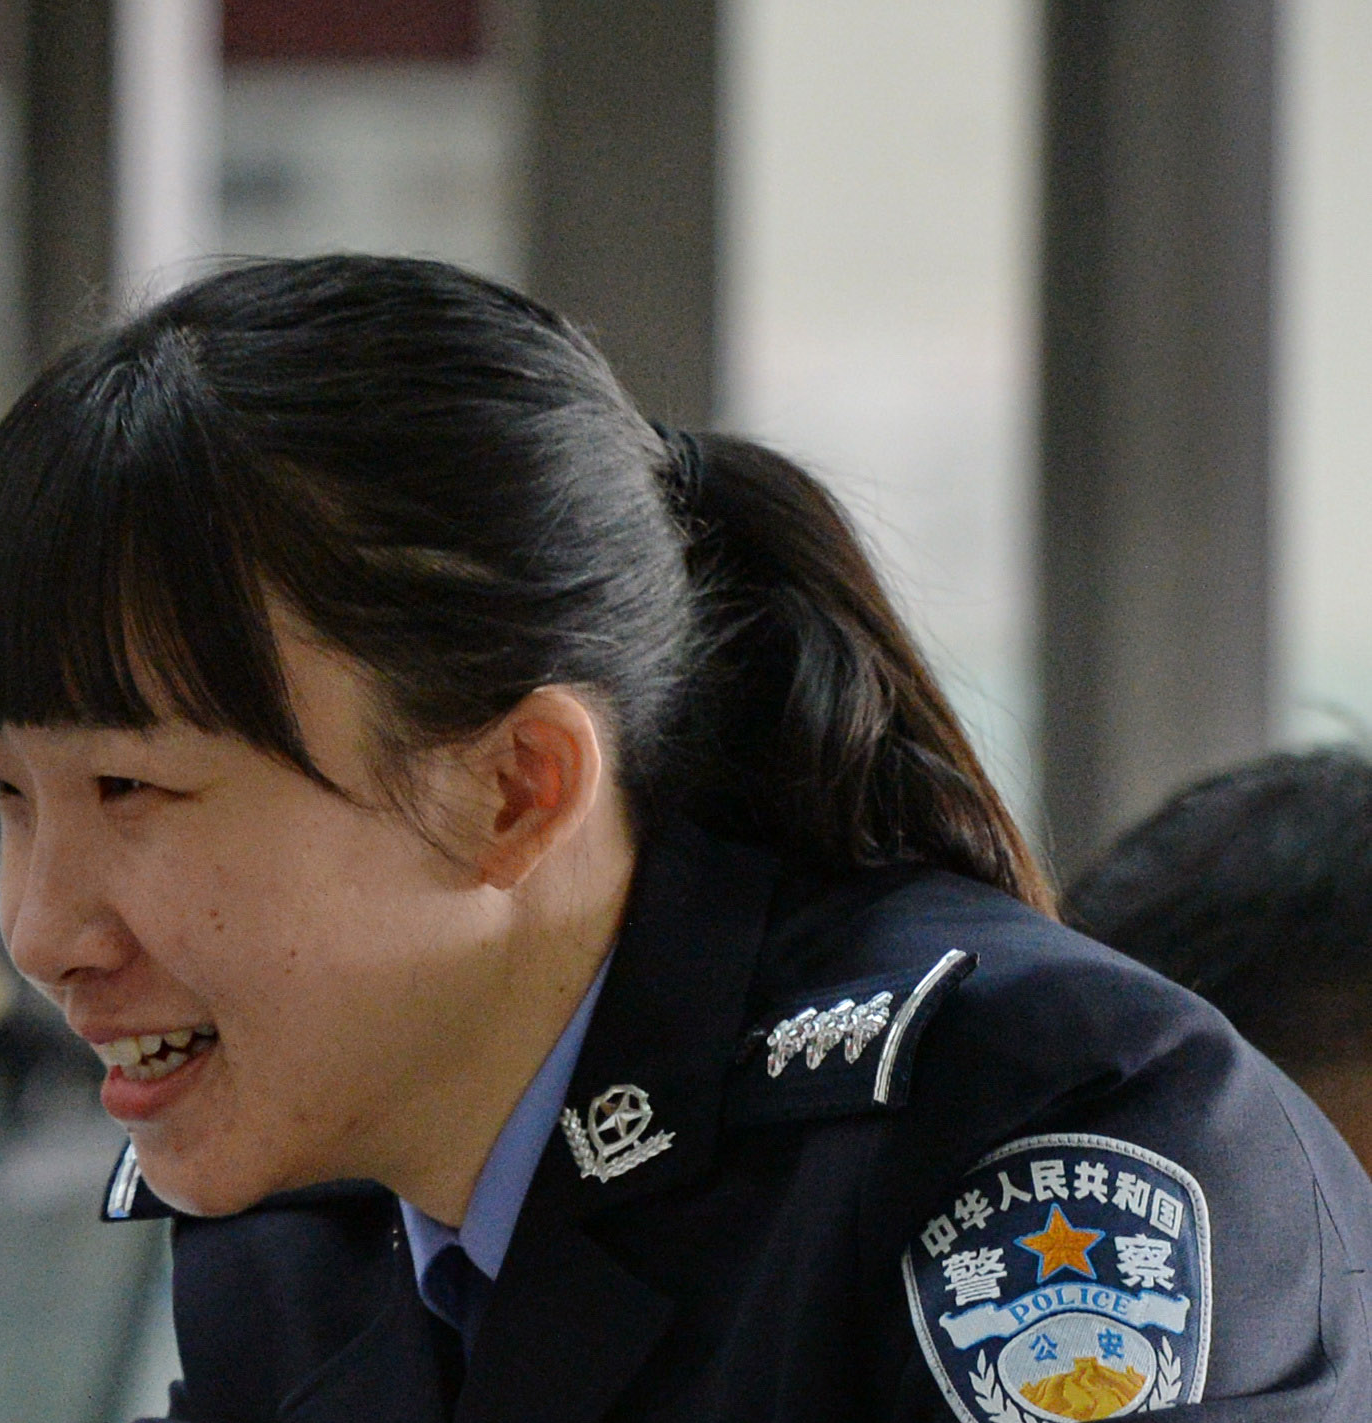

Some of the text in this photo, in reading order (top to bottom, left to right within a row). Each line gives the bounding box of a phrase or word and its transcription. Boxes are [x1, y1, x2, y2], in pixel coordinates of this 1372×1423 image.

[920, 1159, 1185, 1258] 中华人民共和国
[1008, 1287, 1128, 1325] POLICE
